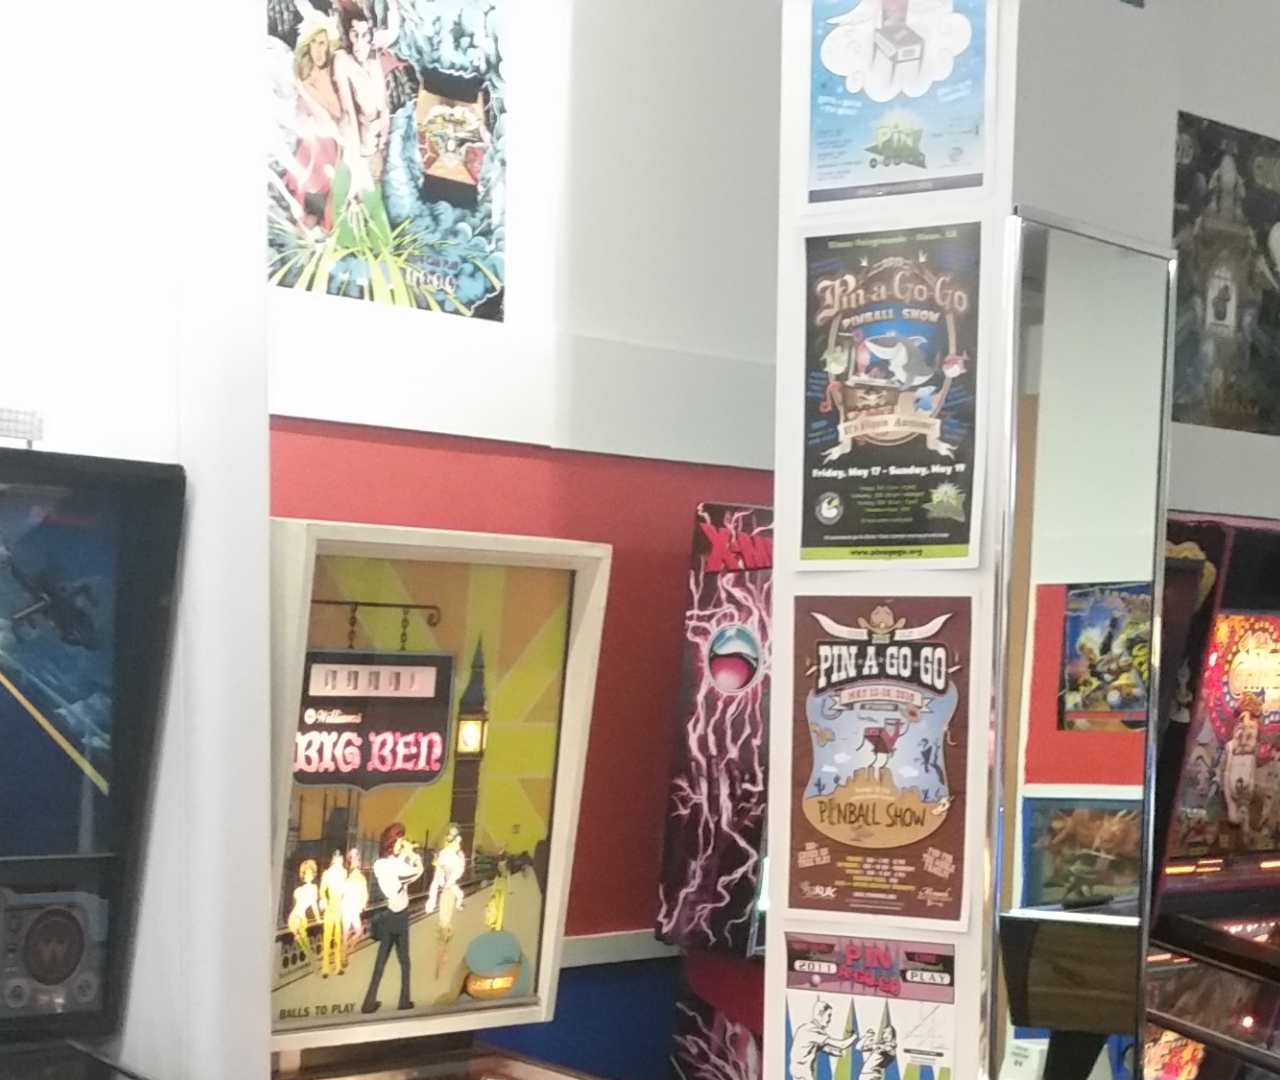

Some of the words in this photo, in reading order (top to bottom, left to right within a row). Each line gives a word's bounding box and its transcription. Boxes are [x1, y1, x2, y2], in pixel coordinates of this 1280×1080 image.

[841, 308, 895, 329] PINBALL
[901, 307, 942, 322] SHOW
[848, 467, 870, 478] May
[931, 464, 953, 475] May
[293, 731, 363, 773] BIG
[366, 731, 445, 773] BEN
[885, 802, 928, 828] SHOW
[844, 943, 893, 969] PIN
[909, 971, 948, 984] PLAY
[279, 1005, 310, 1020] BALLS
[315, 1005, 329, 1017] TO
[331, 1003, 357, 1017] PLAY
